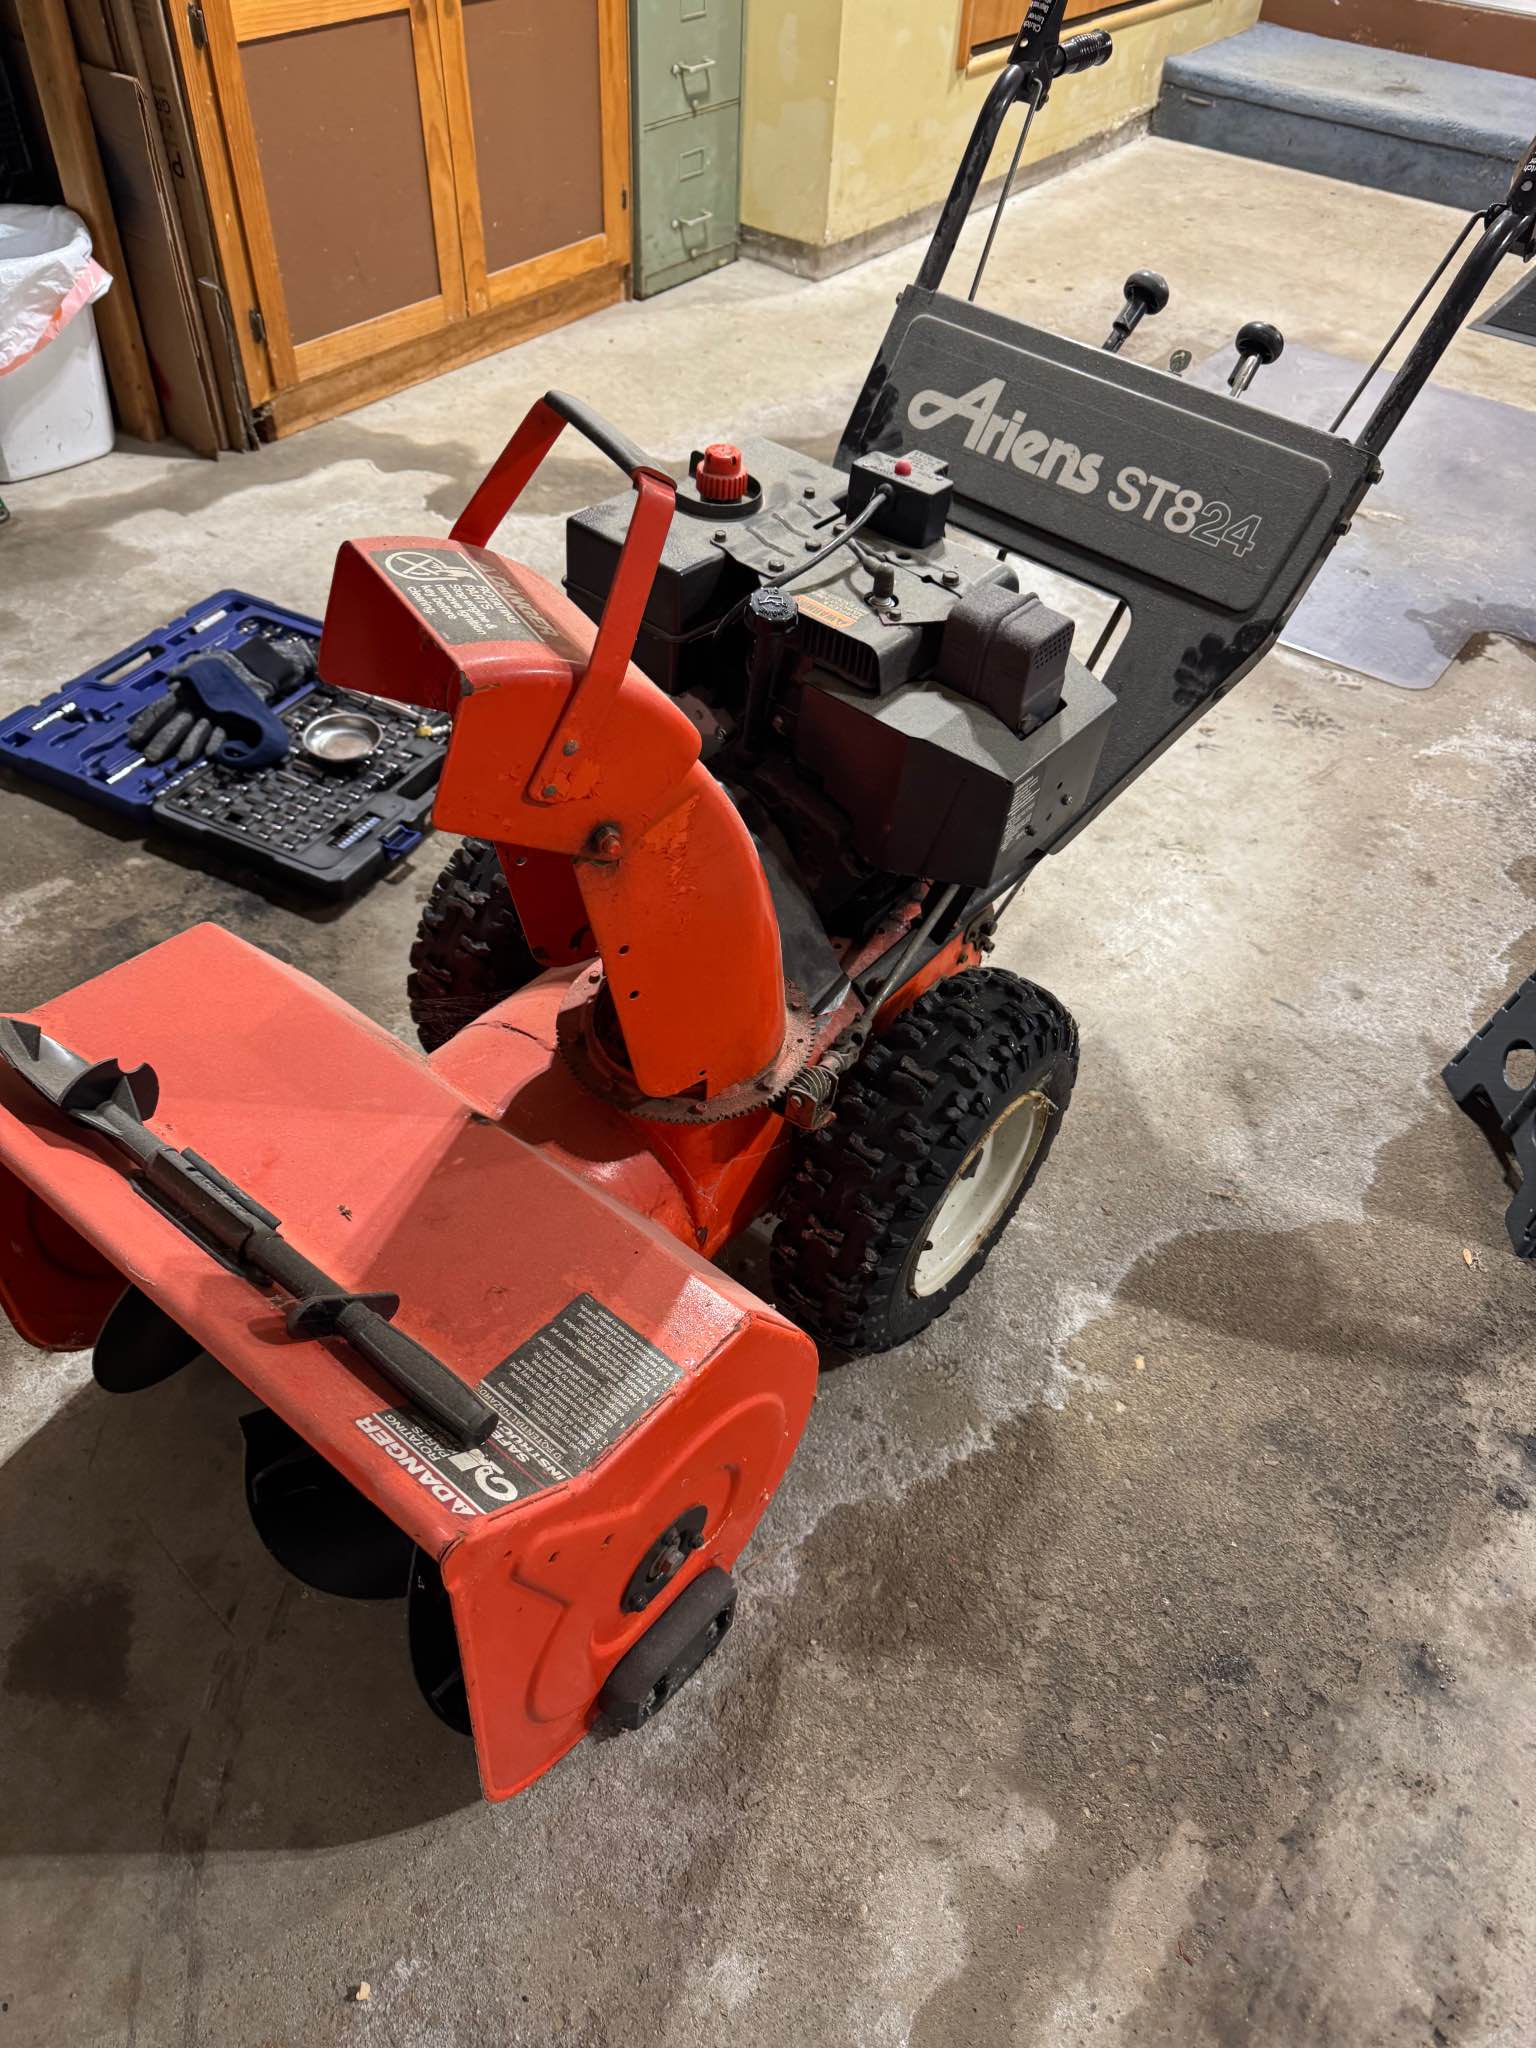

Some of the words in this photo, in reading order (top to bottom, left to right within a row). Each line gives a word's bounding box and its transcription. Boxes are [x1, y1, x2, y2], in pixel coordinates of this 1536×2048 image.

[907, 377, 1105, 495] Ariens
[1107, 465, 1262, 558] ST824
[420, 584, 438, 597] key
[432, 597, 457, 620] before
[435, 584, 463, 609] remove
[456, 609, 486, 635] ignition
[450, 584, 468, 600] Stop
[463, 599, 490, 623] engine
[462, 584, 494, 610] PARTS
[476, 585, 520, 624] ROTATING
[384, 1414, 440, 1462] ROTATING
[411, 1426, 450, 1458] PARTS
[488, 1428, 531, 1463] SAFE
[496, 1419, 566, 1480] INSTRUC
[355, 1416, 458, 1502] DANGER
